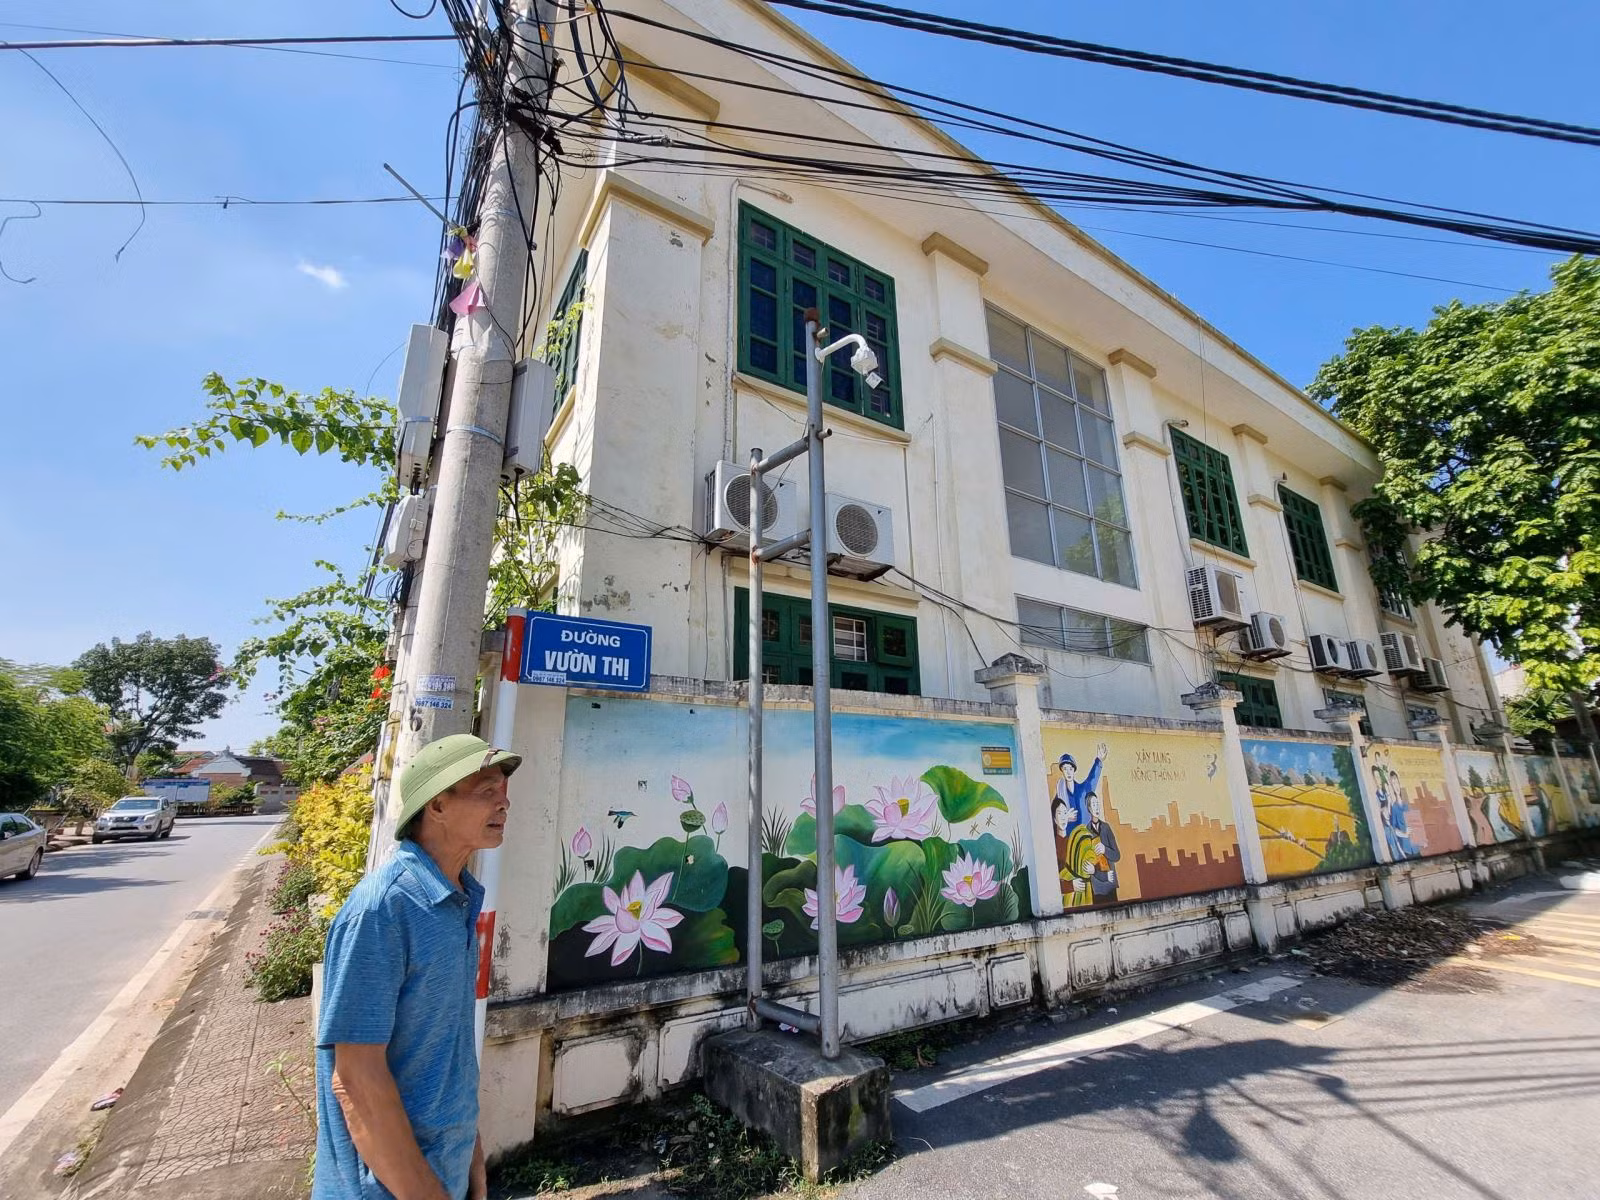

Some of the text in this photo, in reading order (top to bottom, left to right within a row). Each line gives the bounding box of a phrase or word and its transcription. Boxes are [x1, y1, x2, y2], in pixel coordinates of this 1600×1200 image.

[560, 629, 621, 648] ĐƯỜNG
[544, 648, 630, 681] VƯỜN THỊ
